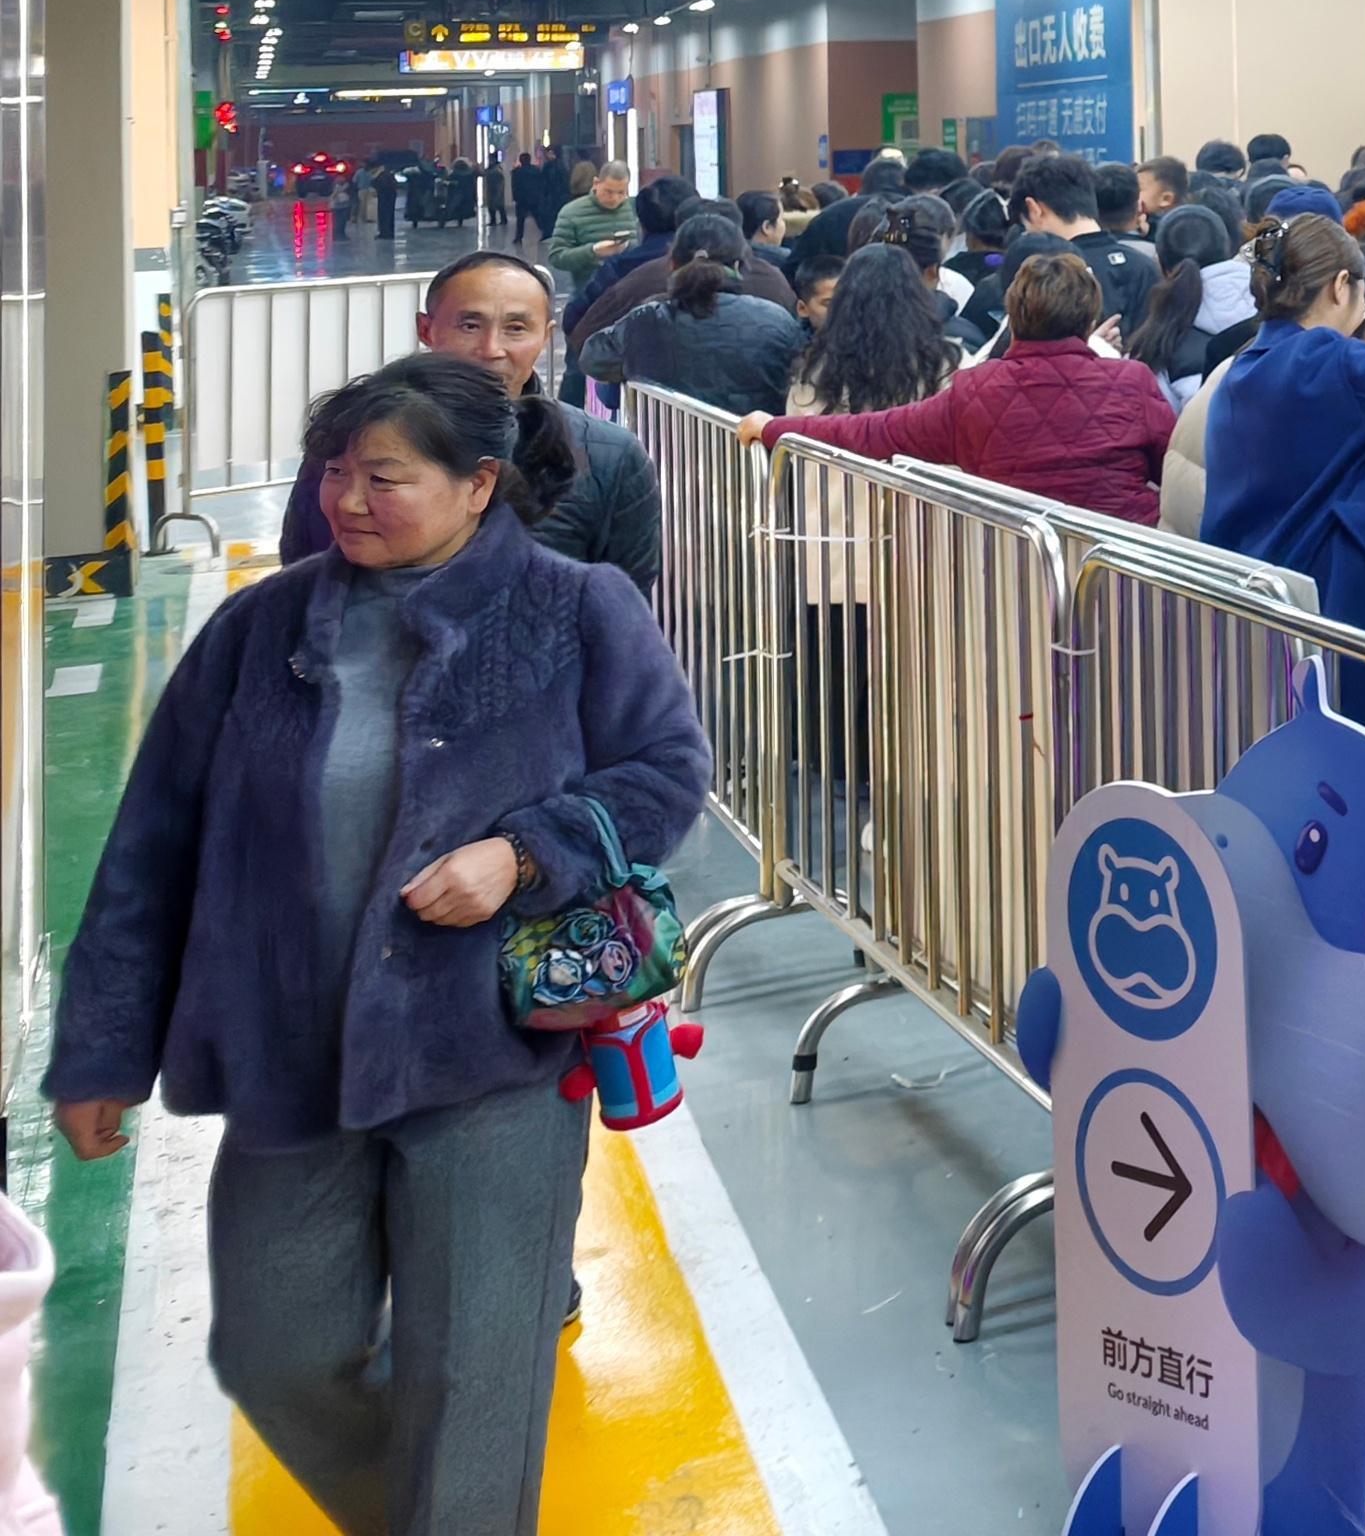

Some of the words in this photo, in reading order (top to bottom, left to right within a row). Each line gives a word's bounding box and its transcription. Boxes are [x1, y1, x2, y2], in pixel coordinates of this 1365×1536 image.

[1014, 3, 1107, 69] 出口无人收费
[1101, 1327, 1214, 1399] 前方直行
[1107, 1382, 1125, 1401] Go
[1126, 1391, 1171, 1417] straight
[1173, 1405, 1210, 1431] ahead
